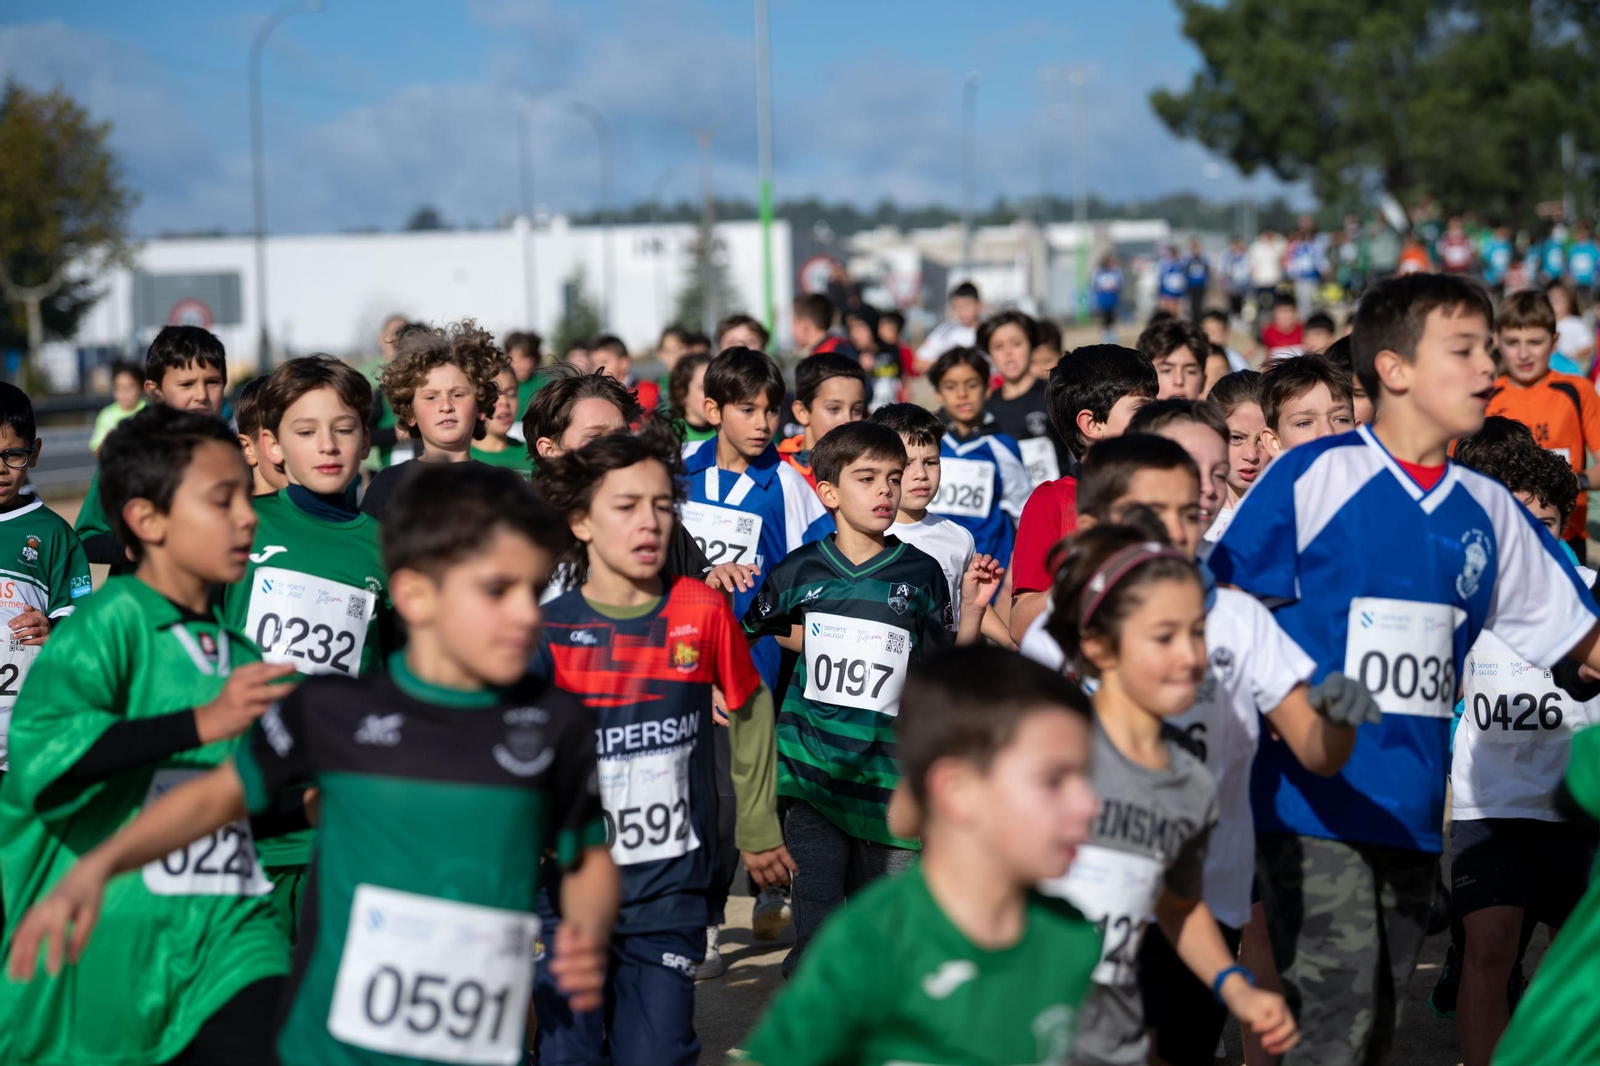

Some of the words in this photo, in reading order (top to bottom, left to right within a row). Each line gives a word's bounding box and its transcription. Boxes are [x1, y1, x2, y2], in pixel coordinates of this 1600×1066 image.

[256, 612, 356, 674] 0232
[823, 625, 847, 634] DEPORTE
[823, 632, 844, 640] GALEGO
[814, 653, 894, 699] 0197
[1360, 650, 1456, 703] 0038
[1473, 692, 1563, 731] 0426
[364, 963, 513, 1043] 0591
